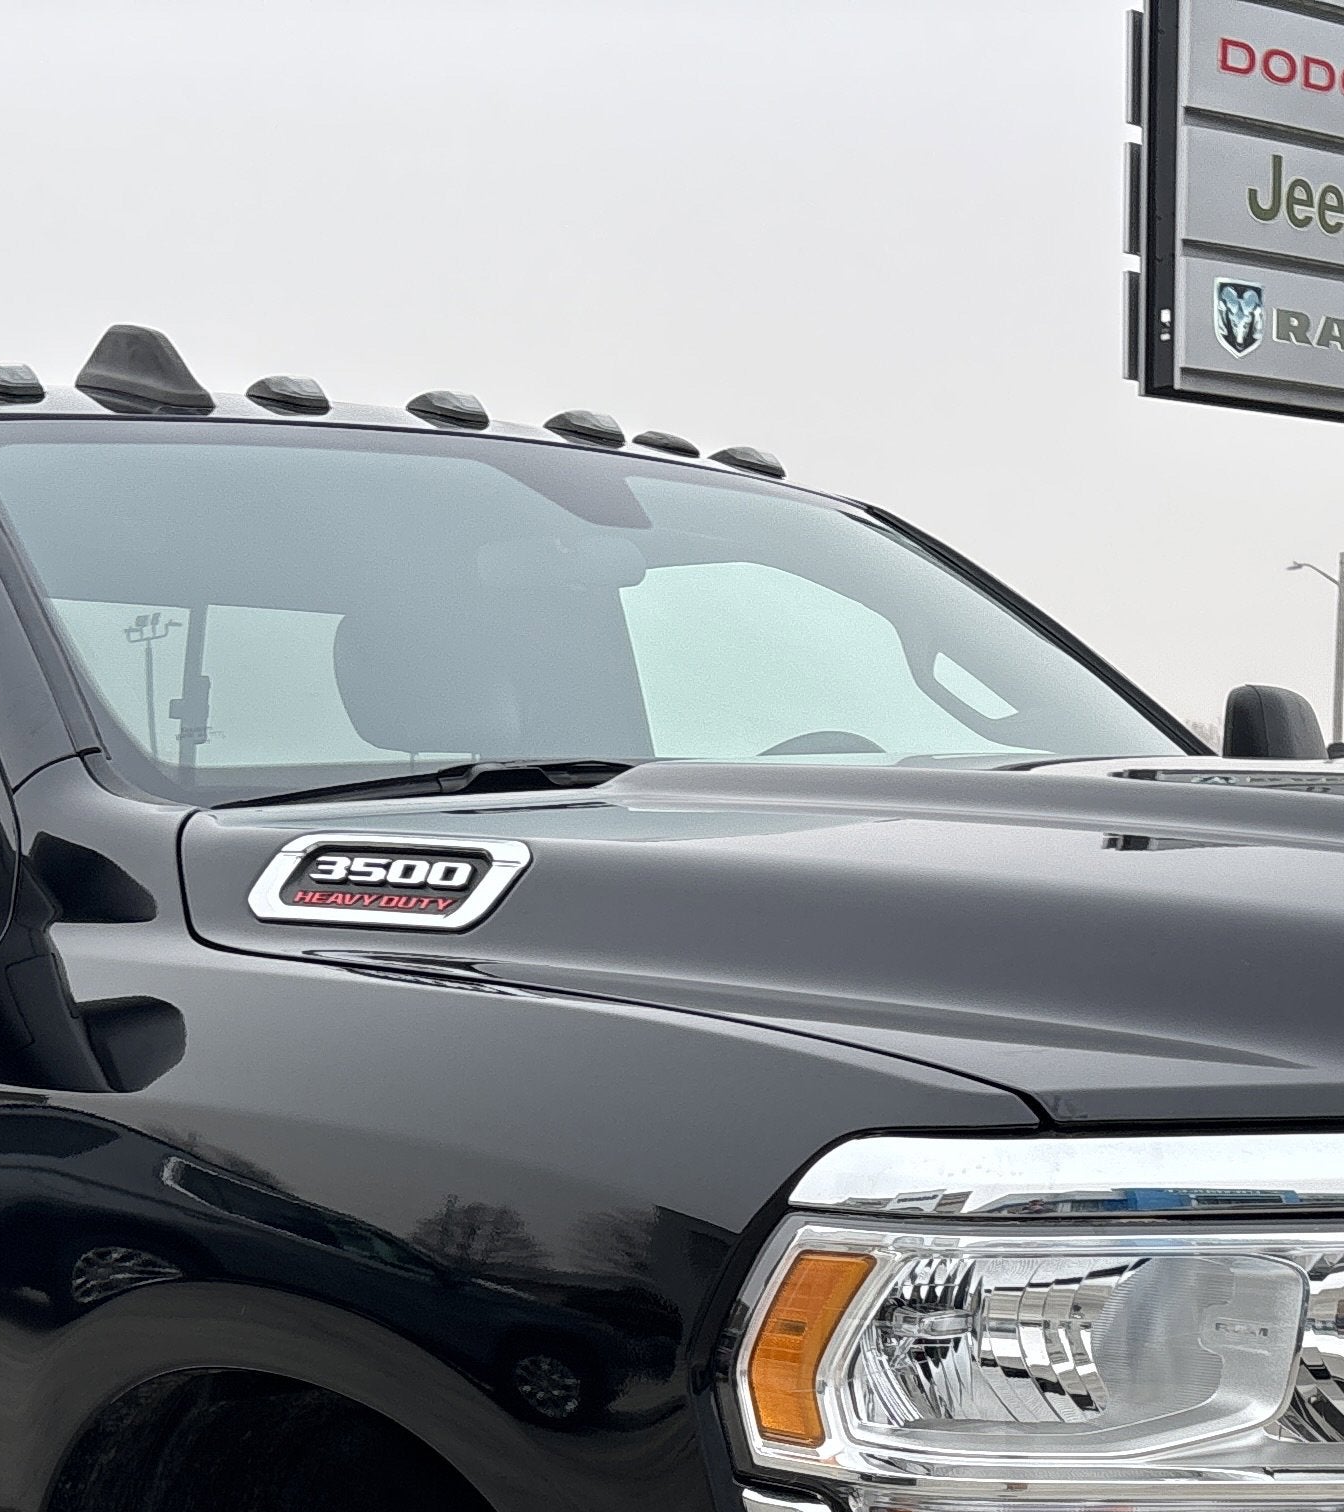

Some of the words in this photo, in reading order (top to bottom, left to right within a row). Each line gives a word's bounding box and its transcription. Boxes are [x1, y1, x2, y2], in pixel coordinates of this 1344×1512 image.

[308, 855, 474, 890] 3500
[293, 890, 380, 907] HEAVY
[378, 894, 454, 911] DUTY
